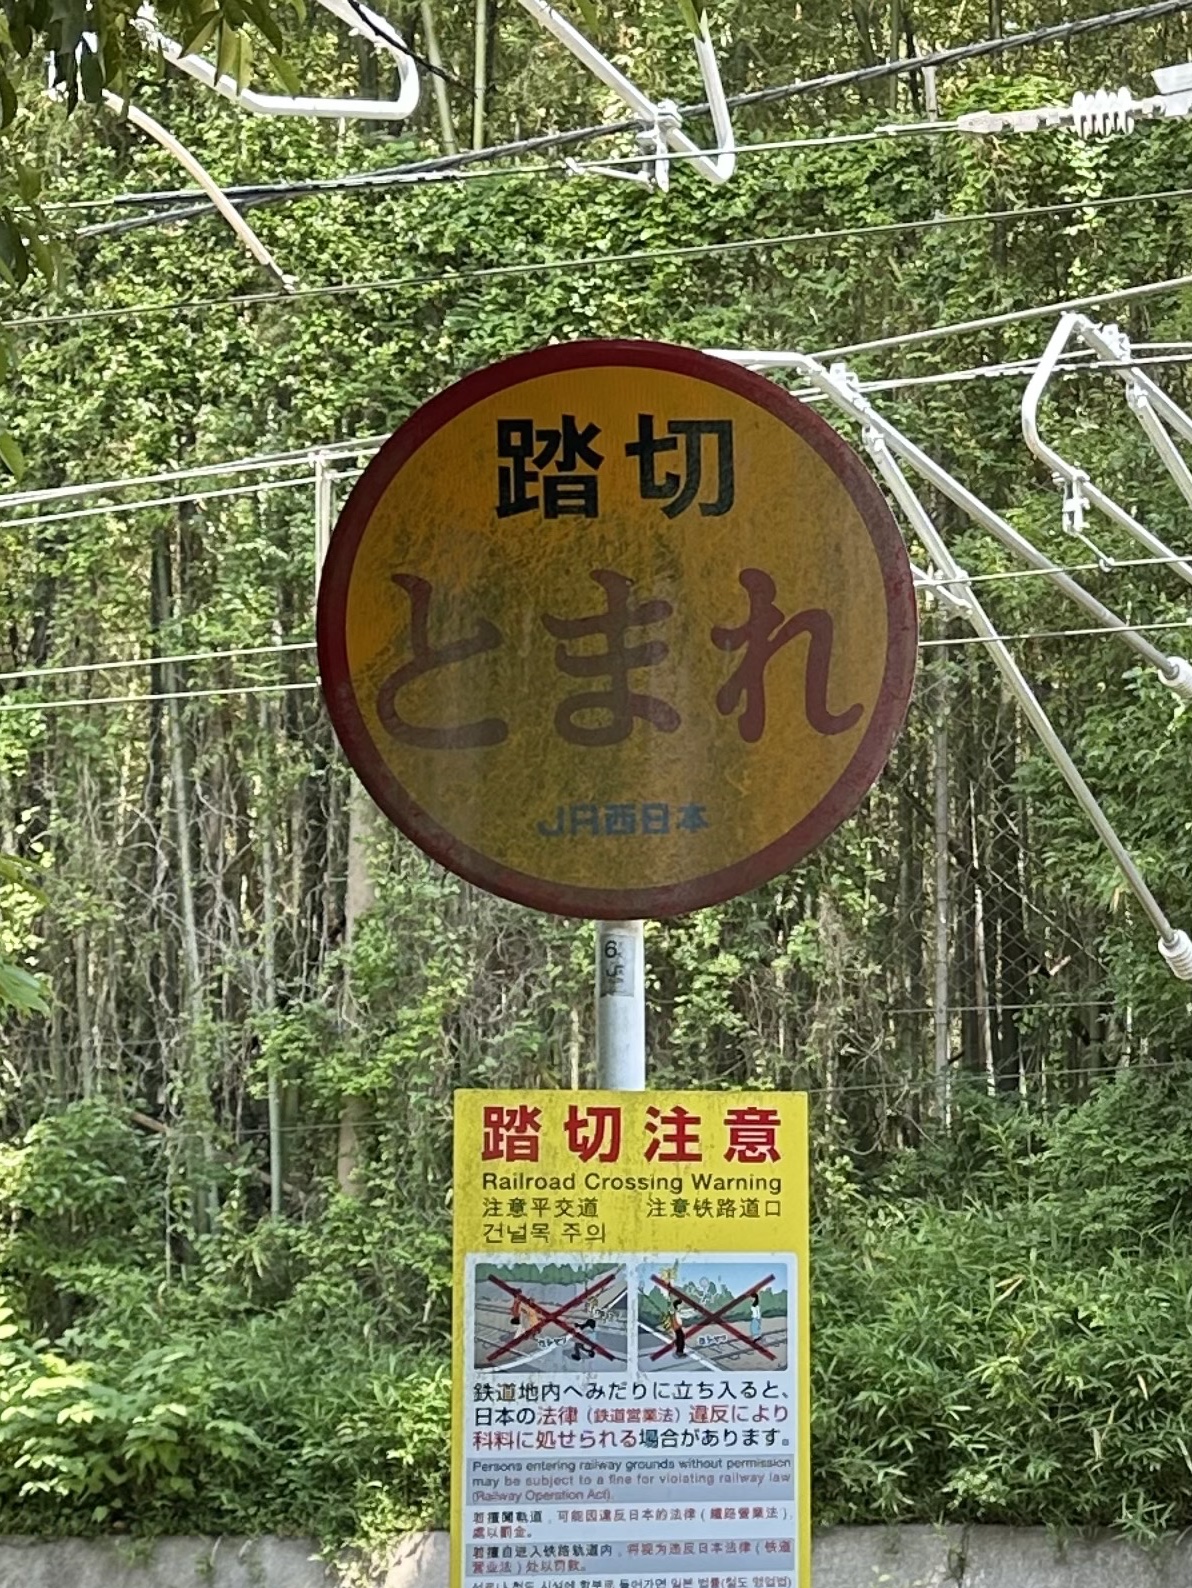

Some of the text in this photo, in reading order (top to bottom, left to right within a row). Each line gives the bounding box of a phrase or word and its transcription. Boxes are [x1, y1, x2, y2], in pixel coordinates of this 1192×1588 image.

[495, 413, 735, 519] 踏切
[375, 567, 864, 750] とまれ
[537, 801, 711, 838] JR西日本
[481, 1104, 782, 1163] 踏切注意
[482, 1173, 782, 1195] Railroad Crossing Warning
[482, 1197, 782, 1218] 注意平交道 注意铁路道口
[482, 1223, 606, 1244] 건널목 주의
[473, 1380, 788, 1402] 鉄道地内へみだりに立ち入ると、
[473, 1428, 789, 1450] 科料に処せられる場合があります。
[472, 1458, 791, 1473] Persons entering railway grounds without permission
[472, 1471, 791, 1488] may be subject to a fine for violating railway law
